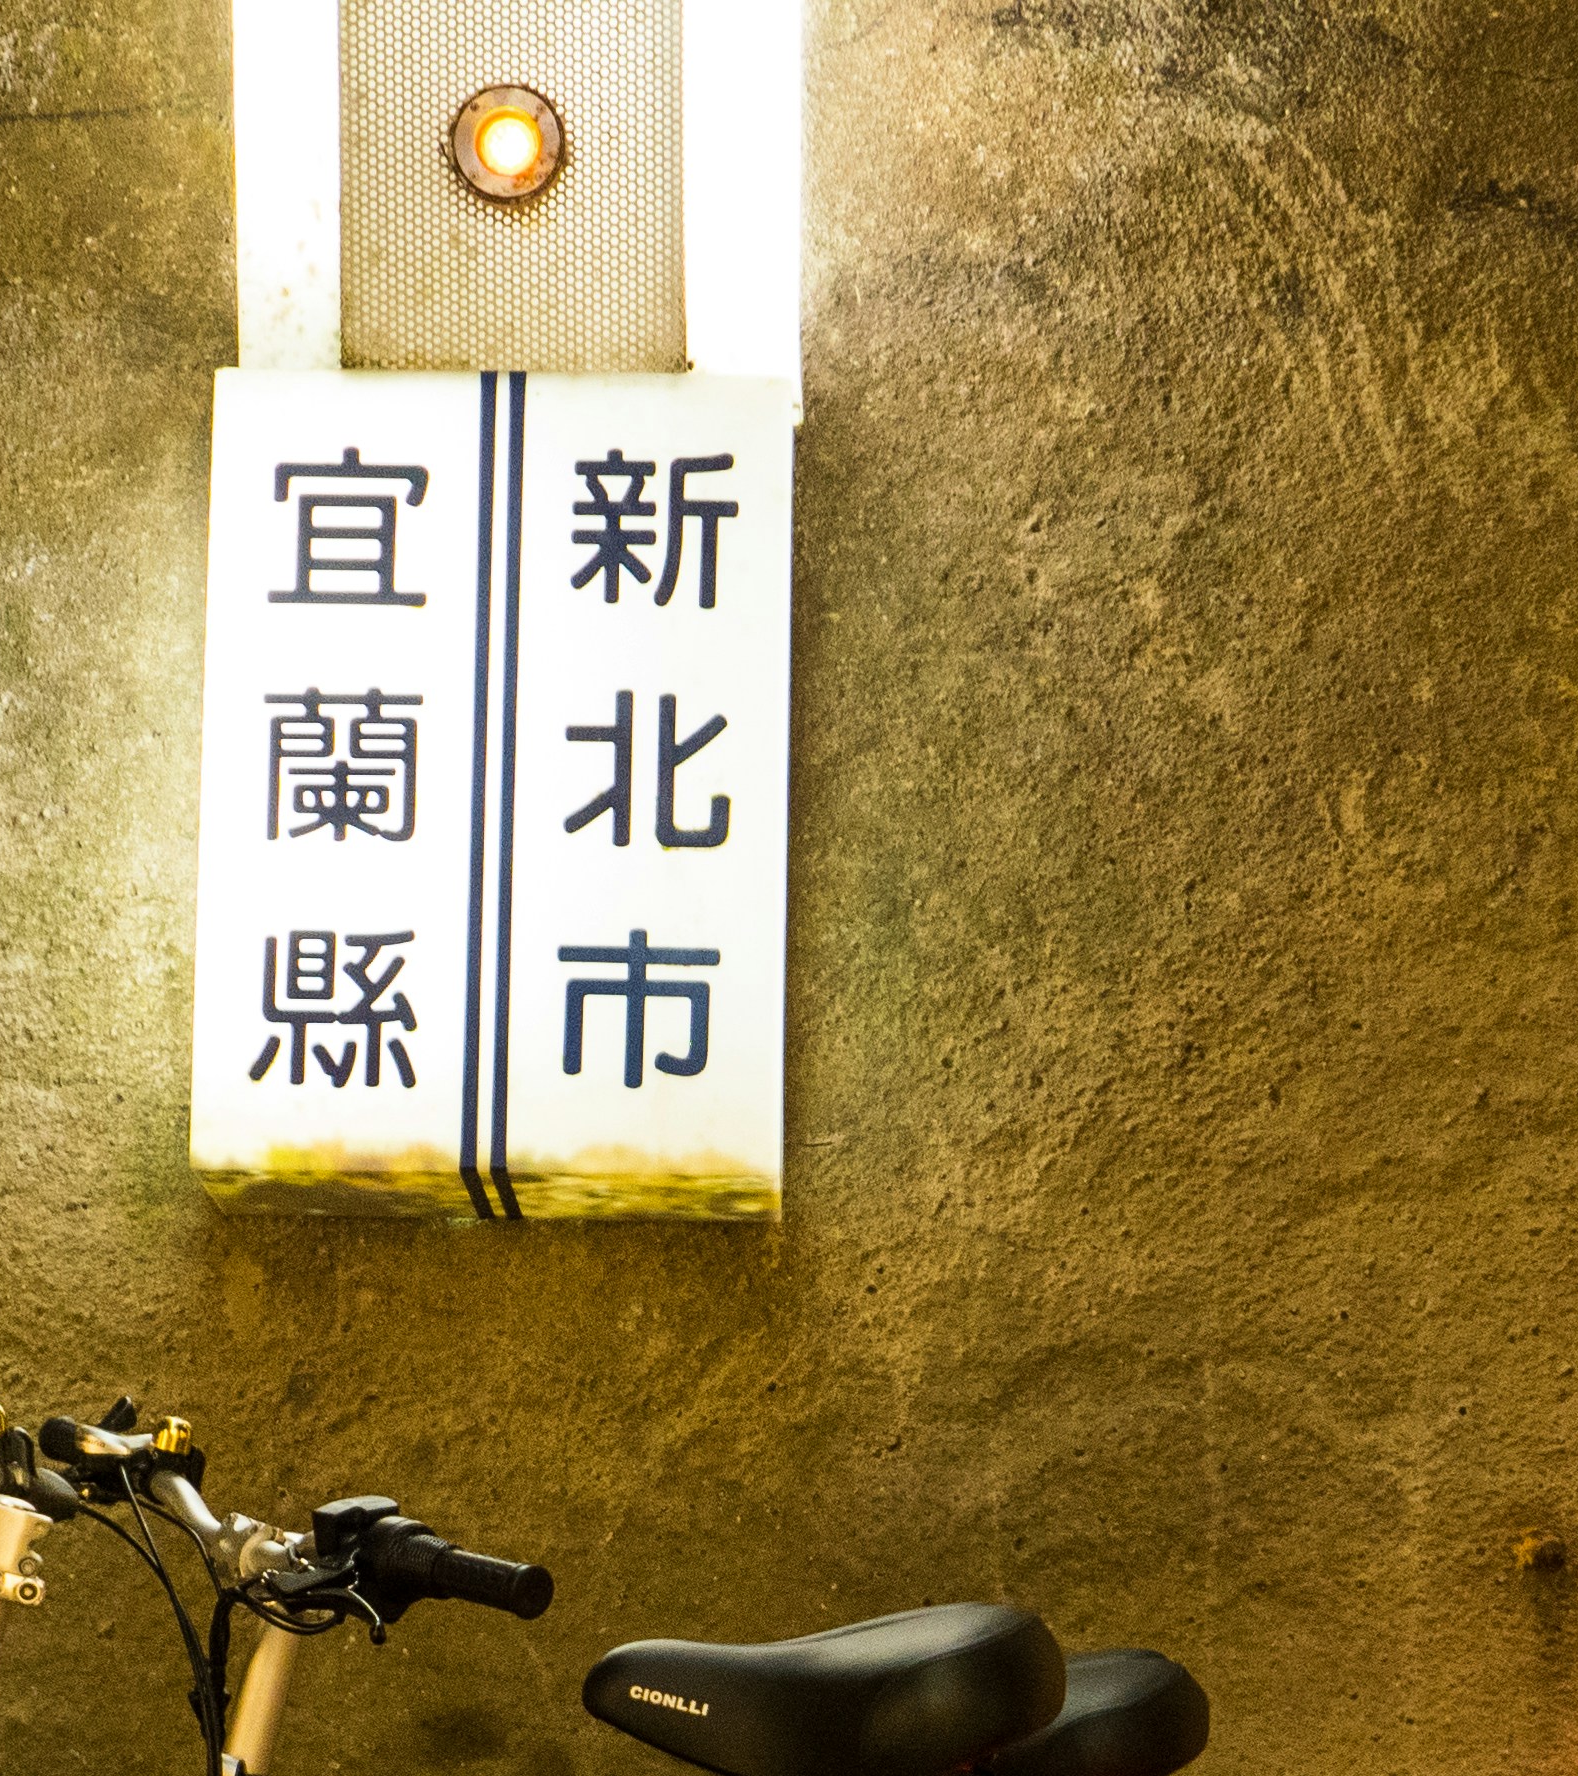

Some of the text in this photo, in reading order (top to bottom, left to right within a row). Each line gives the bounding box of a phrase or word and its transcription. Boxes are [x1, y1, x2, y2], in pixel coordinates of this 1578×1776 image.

[249, 446, 429, 1088] 宜蘭縣
[557, 449, 739, 1088] 新北市
[629, 1685, 709, 1716] CIONLLI
